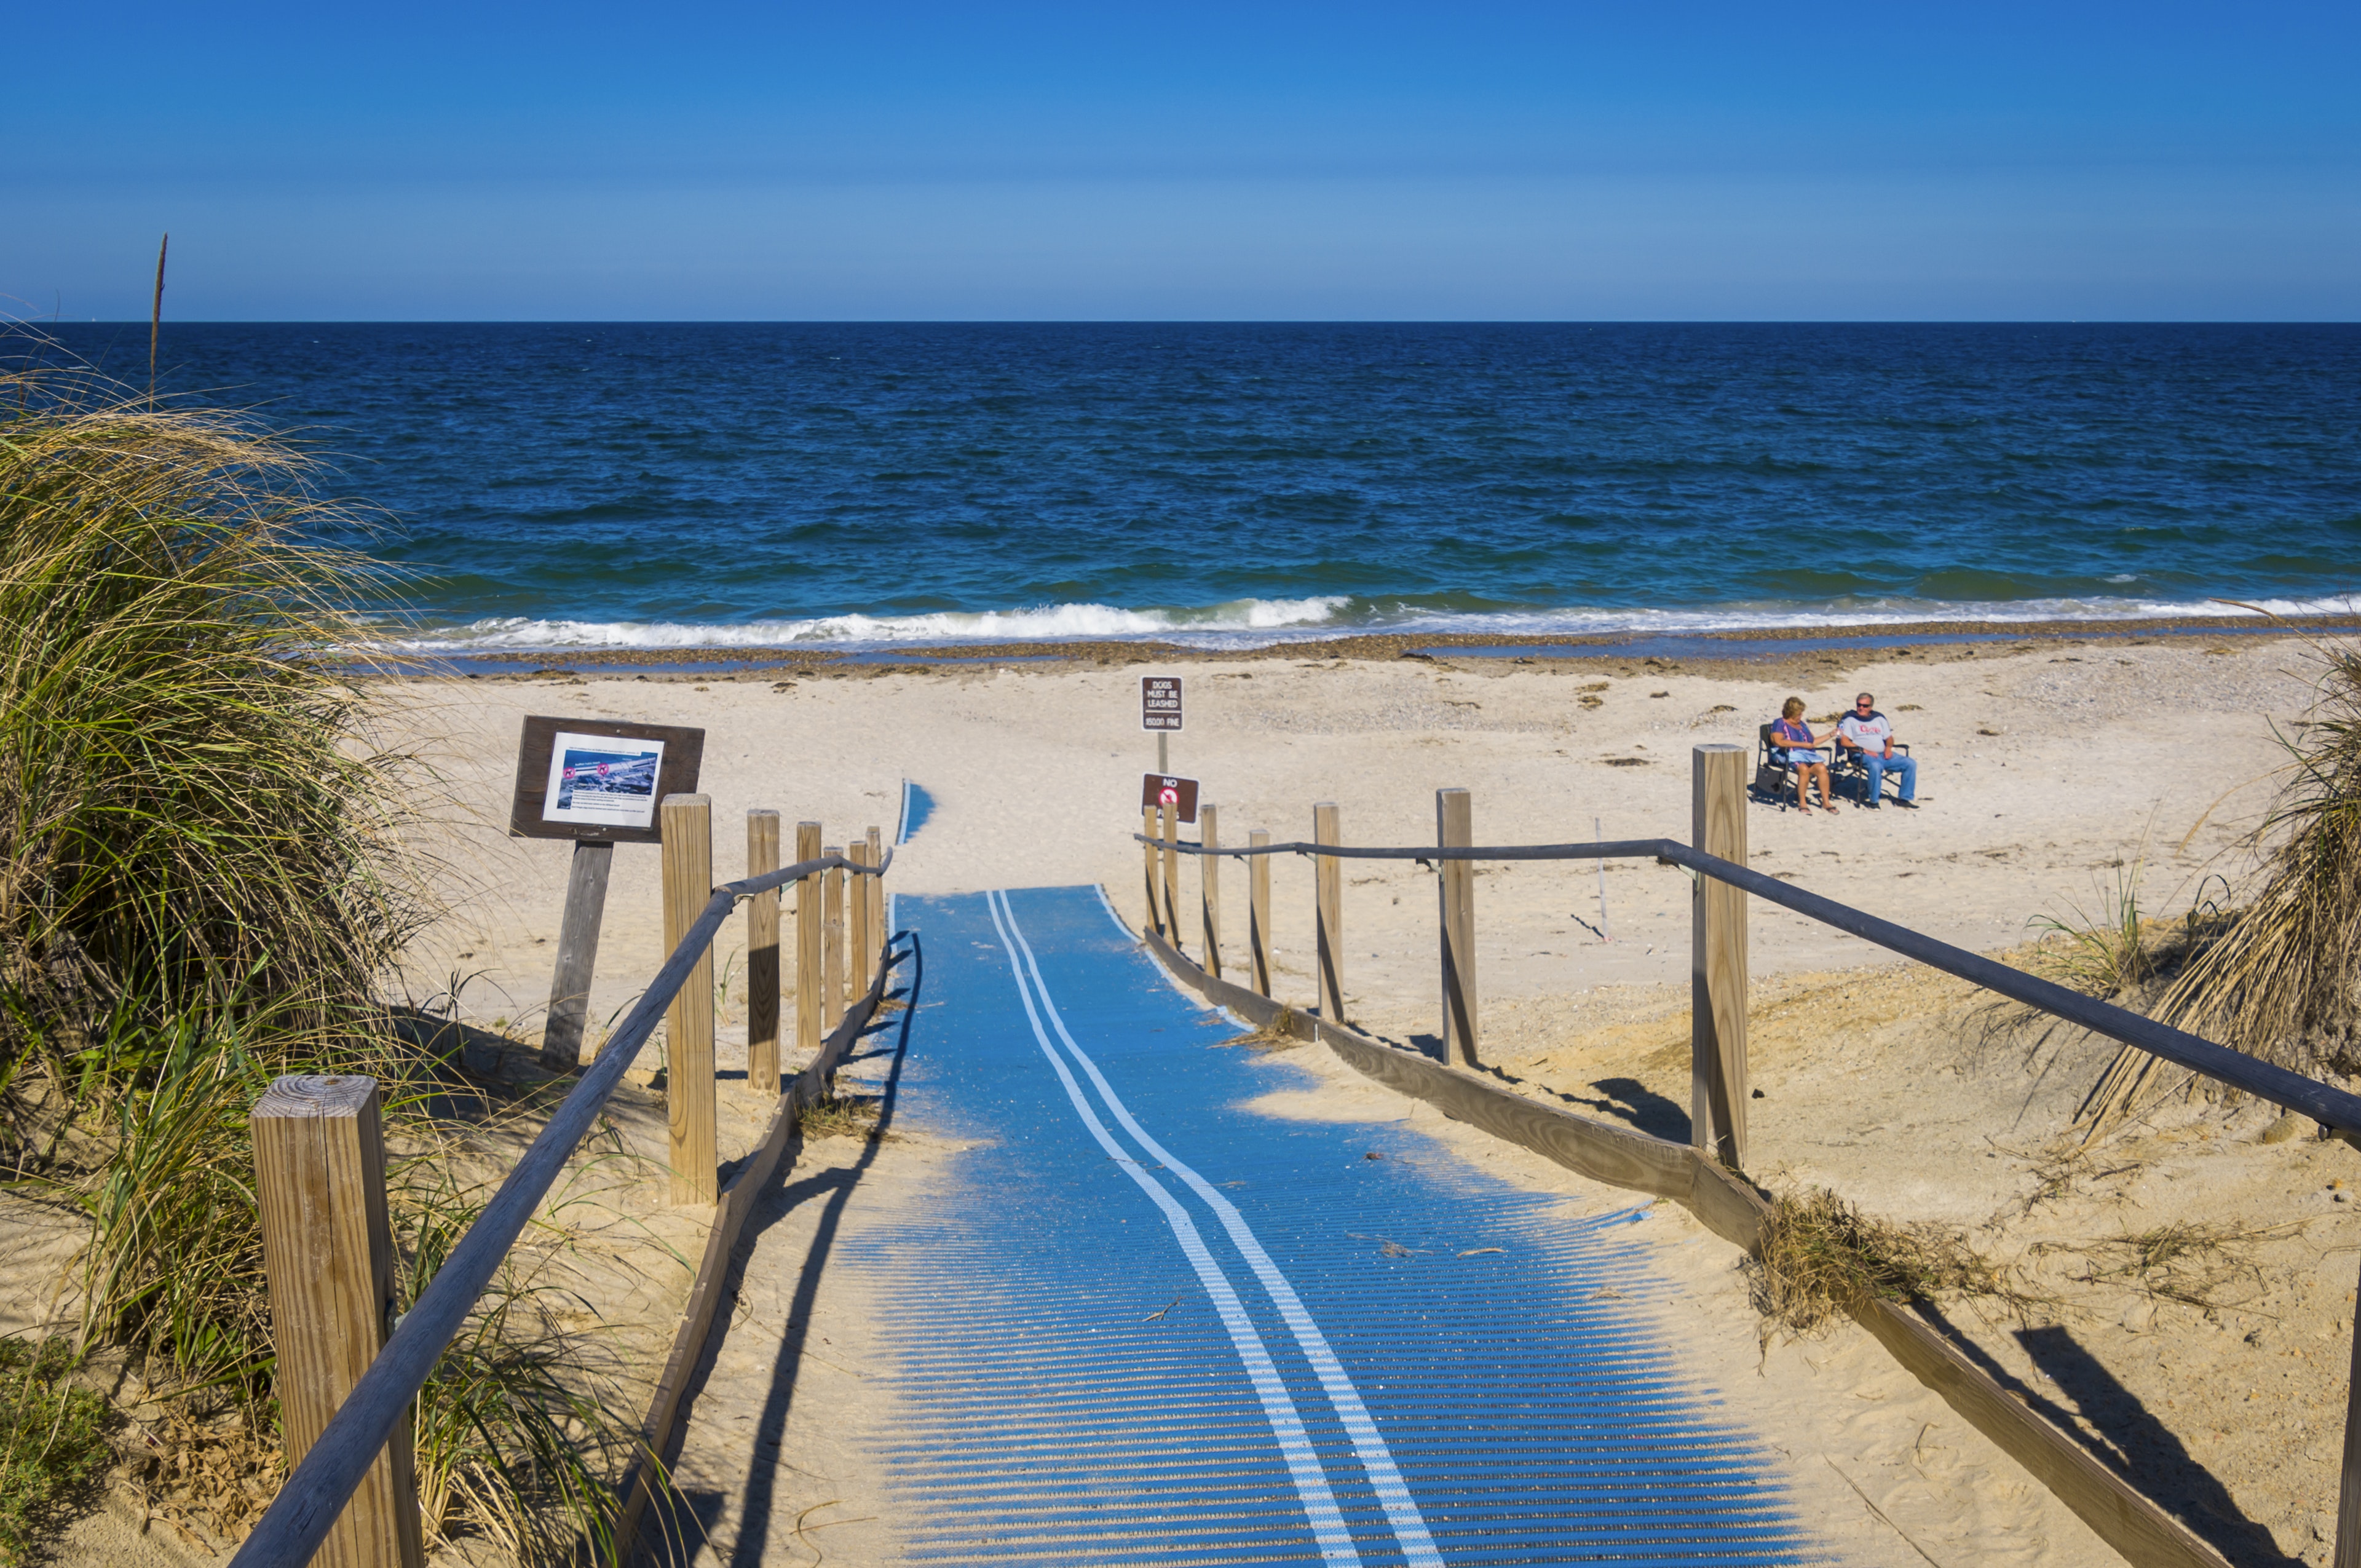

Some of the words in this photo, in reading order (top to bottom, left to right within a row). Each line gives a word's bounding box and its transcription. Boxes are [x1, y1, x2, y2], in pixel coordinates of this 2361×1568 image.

[1152, 681, 1172, 689] DOGS
[1169, 690, 1178, 699] BE
[1147, 699, 1178, 708] LEASHED
[1167, 718, 1180, 726] FINE
[1163, 778, 1177, 788] NO
